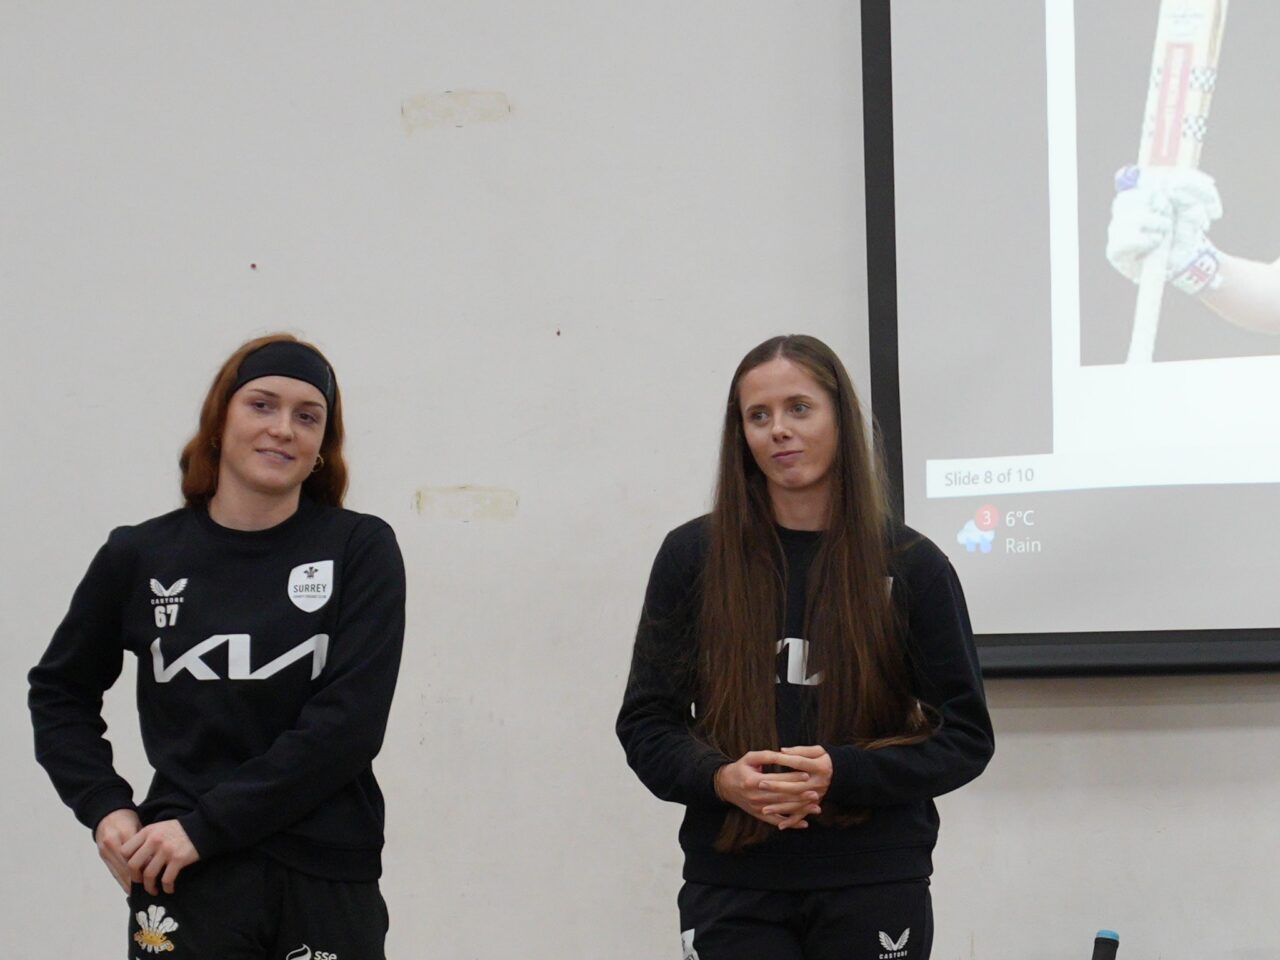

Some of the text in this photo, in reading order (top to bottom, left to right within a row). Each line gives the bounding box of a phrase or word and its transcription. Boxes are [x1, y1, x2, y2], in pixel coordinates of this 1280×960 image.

[944, 467, 1034, 487] Slide 8 of 10
[982, 510, 992, 526] 3
[1005, 537, 1042, 553] Rain
[293, 584, 327, 593] SURREY
[154, 604, 179, 628] 67
